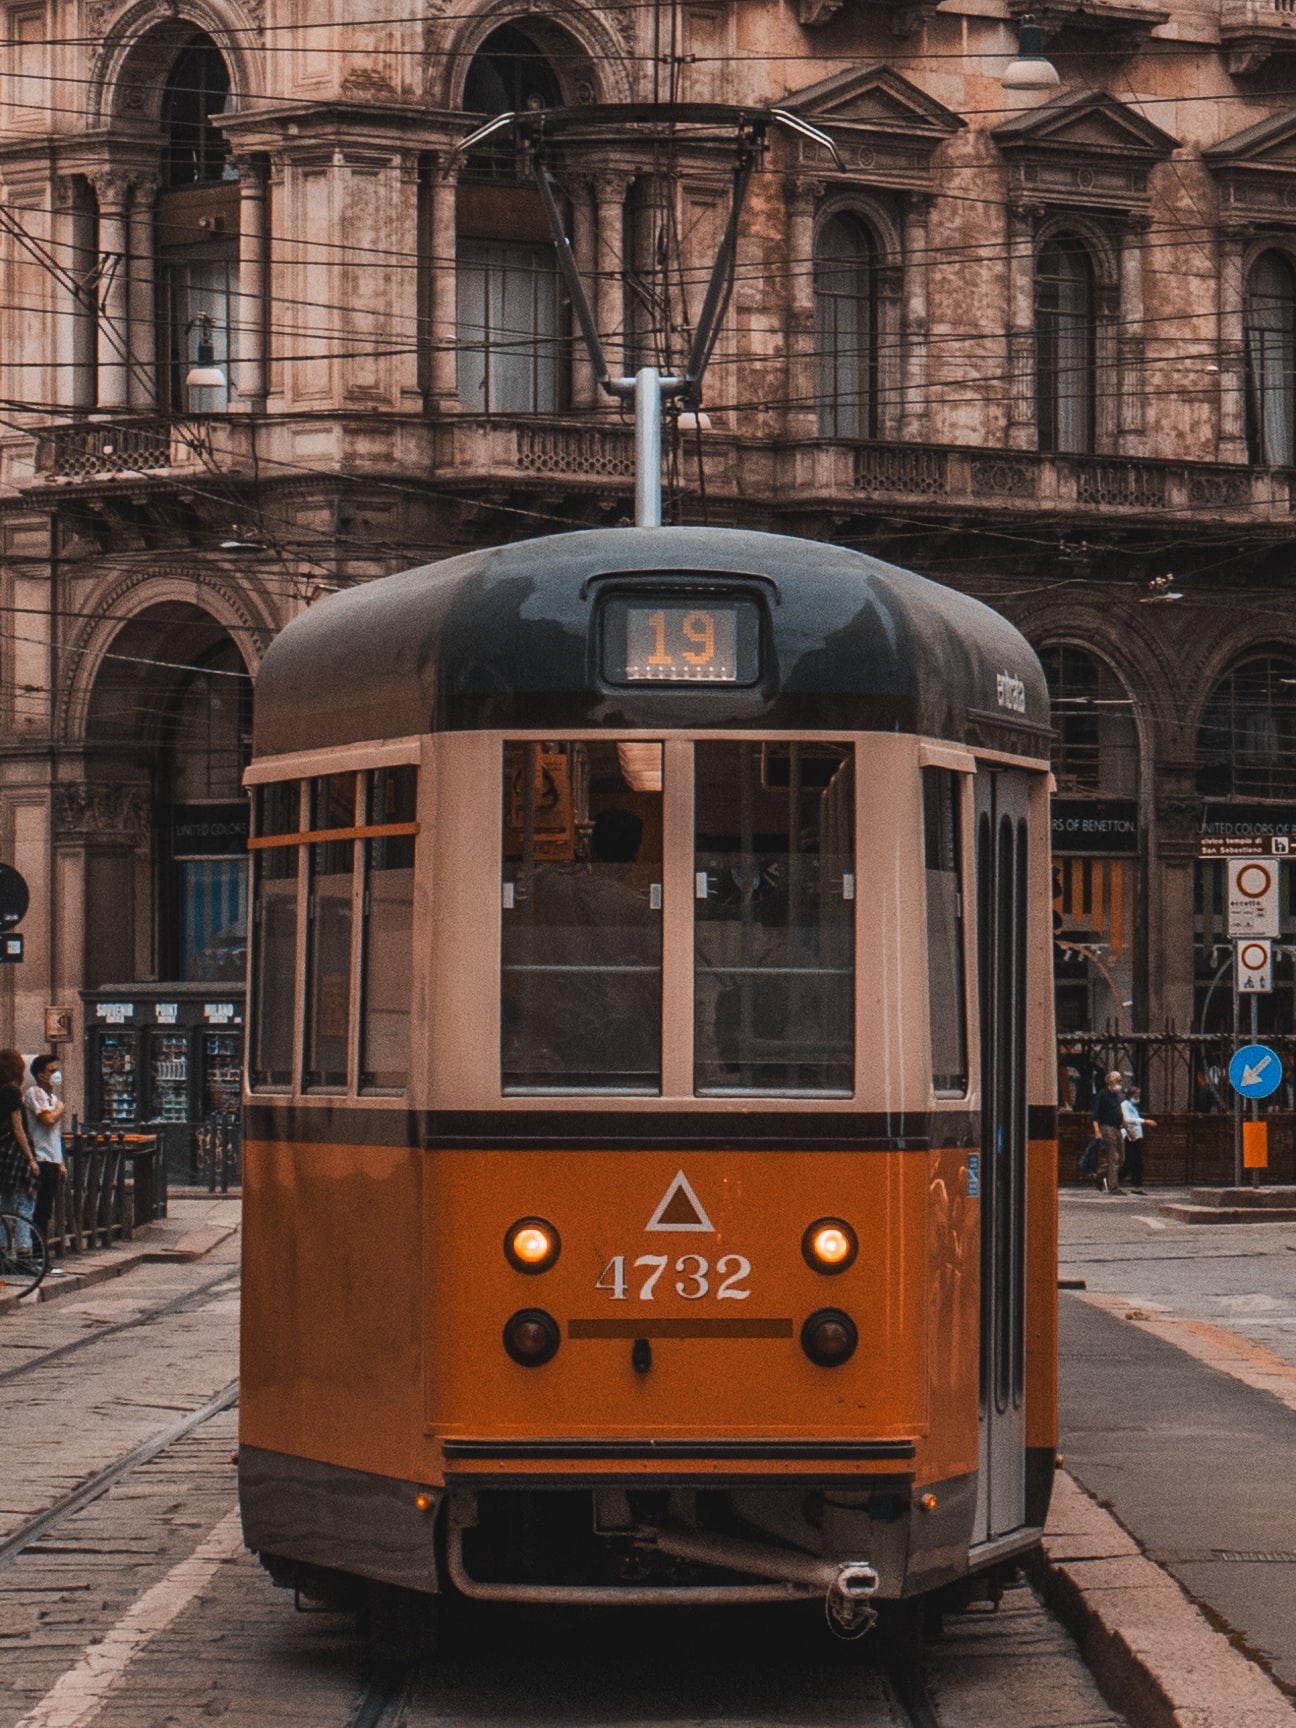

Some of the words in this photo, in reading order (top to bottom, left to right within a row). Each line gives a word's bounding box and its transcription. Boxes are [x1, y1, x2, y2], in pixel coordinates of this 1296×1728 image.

[646, 610, 716, 665] 19
[1234, 823, 1275, 836] COLORS
[595, 1247, 752, 1301] 4732
